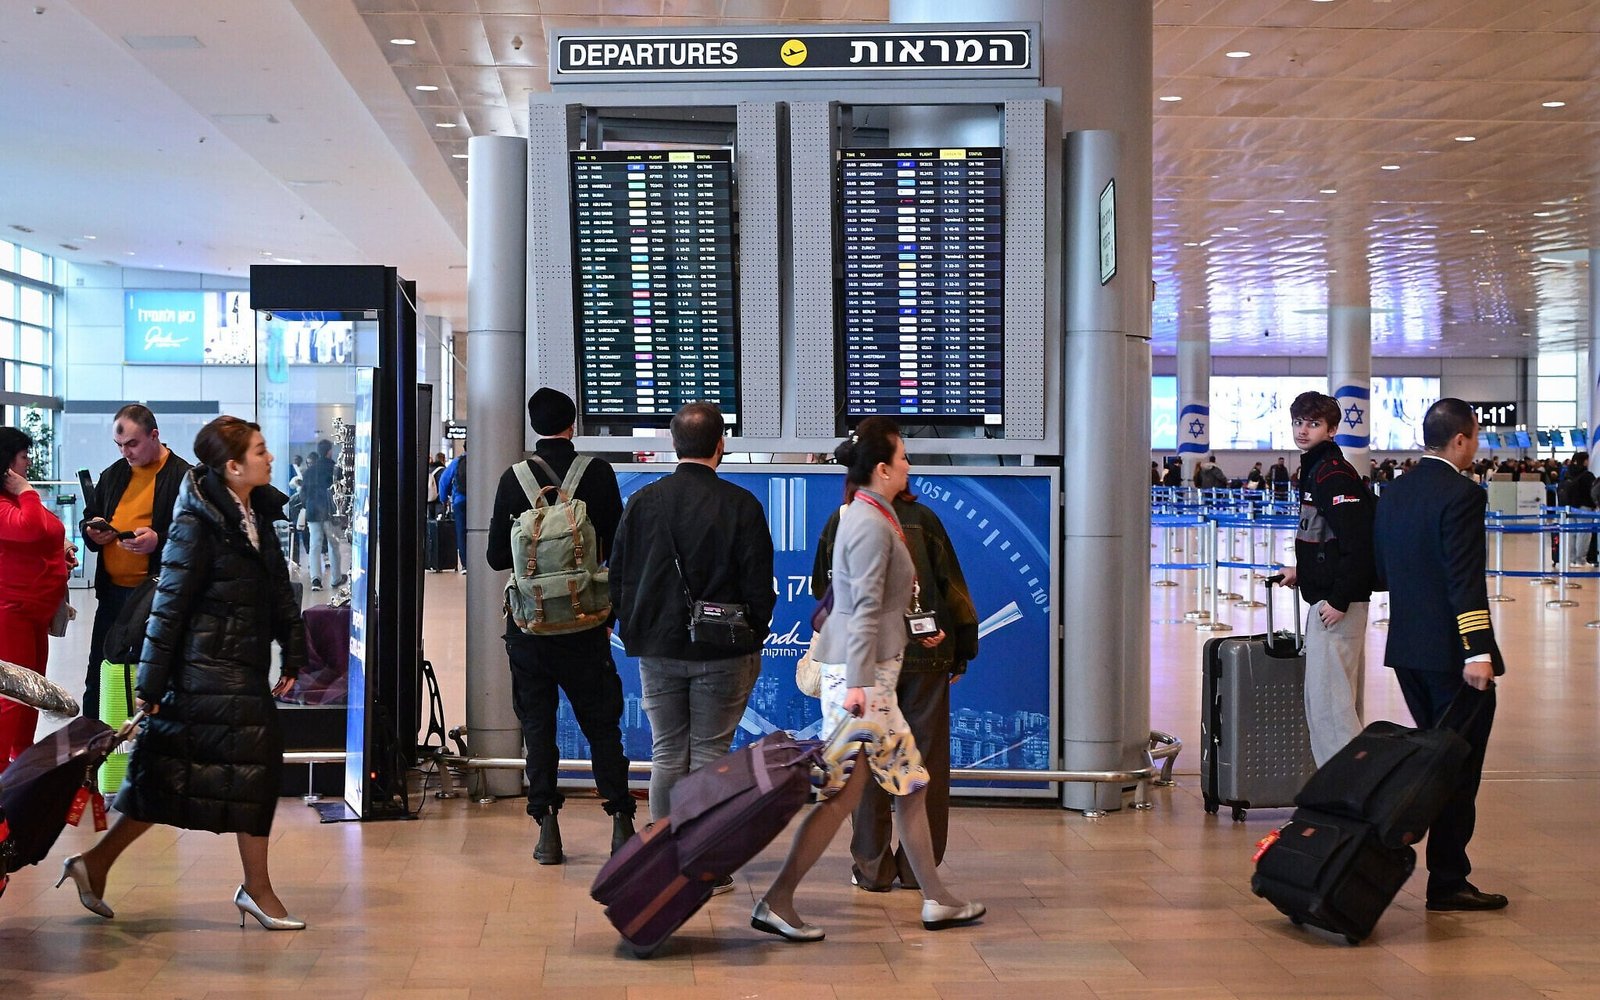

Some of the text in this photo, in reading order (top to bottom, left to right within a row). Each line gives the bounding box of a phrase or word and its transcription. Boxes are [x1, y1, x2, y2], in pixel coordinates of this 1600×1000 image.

[569, 41, 739, 67] DEPARTURES
[849, 38, 1014, 64] המראות
[921, 481, 942, 499] 05
[1030, 587, 1048, 605] 10
[761, 649, 798, 659] החזקות
